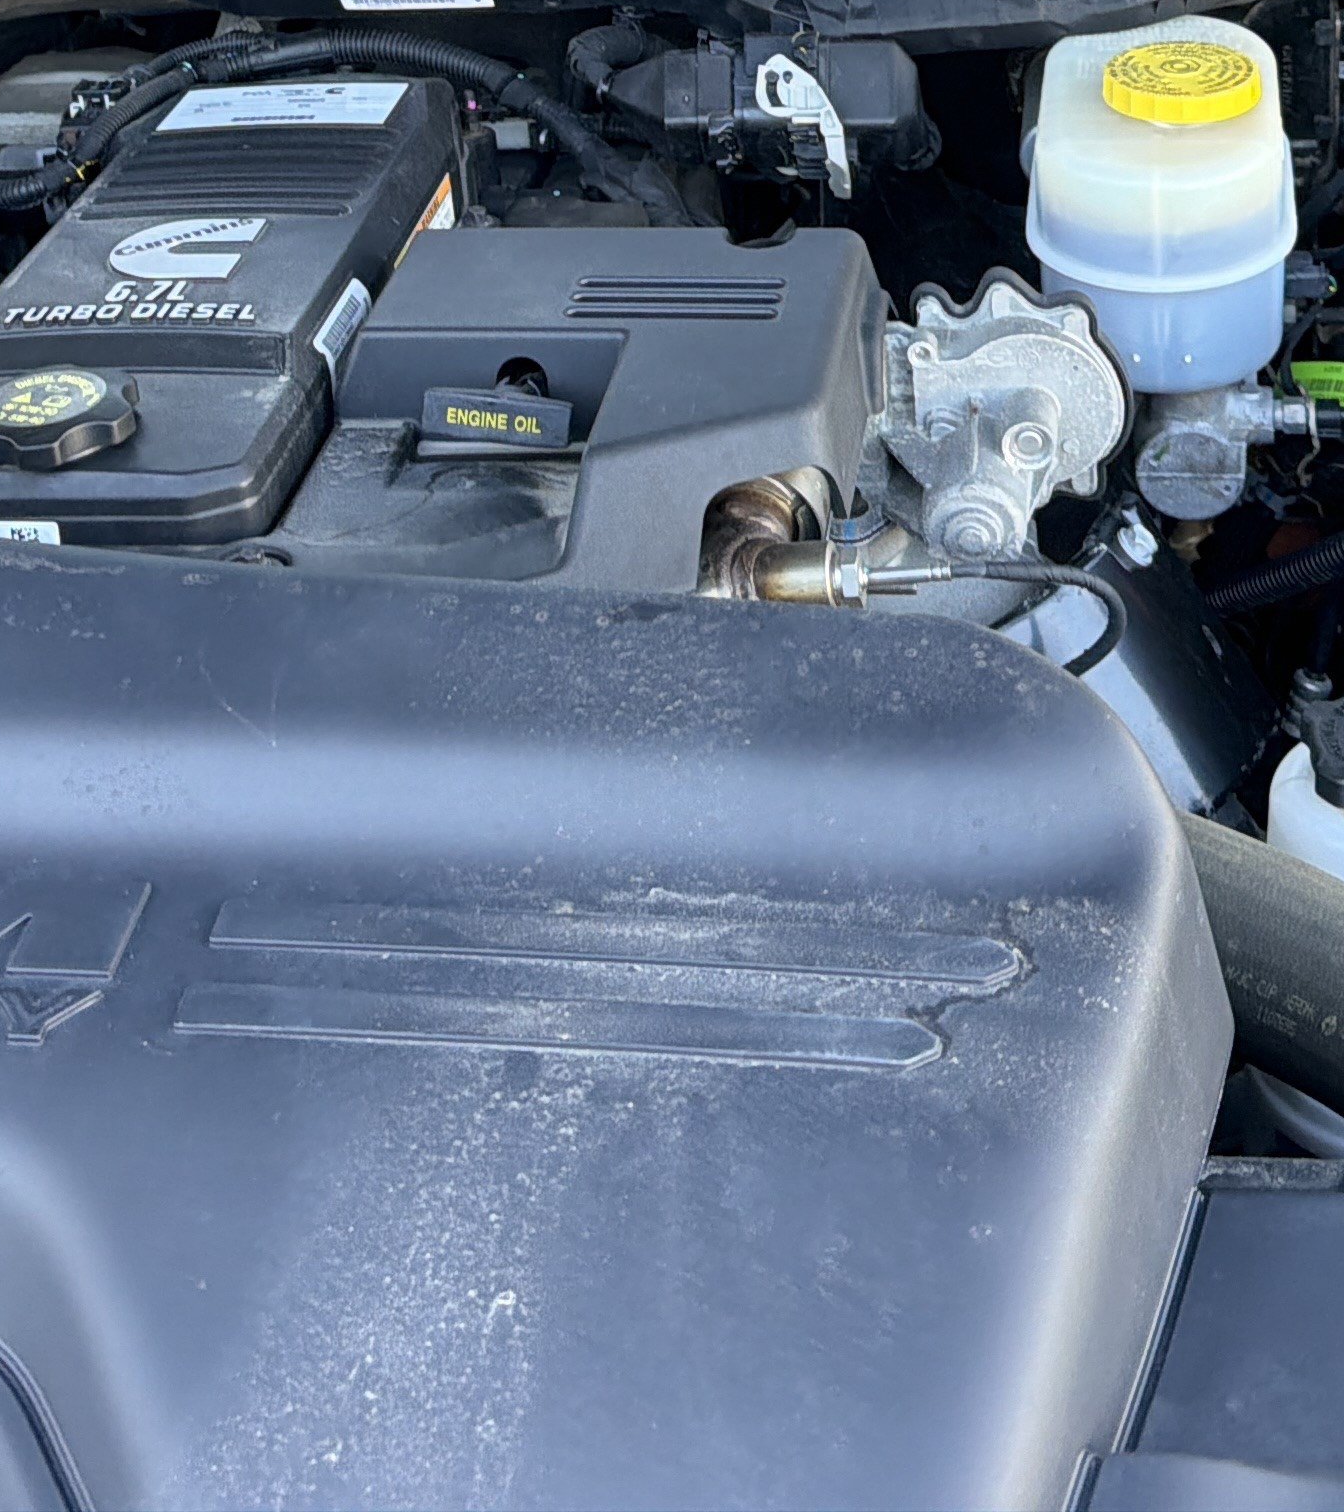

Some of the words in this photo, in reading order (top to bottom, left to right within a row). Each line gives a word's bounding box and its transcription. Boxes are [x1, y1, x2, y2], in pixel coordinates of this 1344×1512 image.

[113, 218, 255, 257] Cummins
[104, 280, 189, 303] 6.7L
[3, 303, 124, 325] TURBO
[129, 302, 256, 322] DIESEL
[446, 406, 509, 431] ENGINE
[514, 414, 542, 434] OIL
